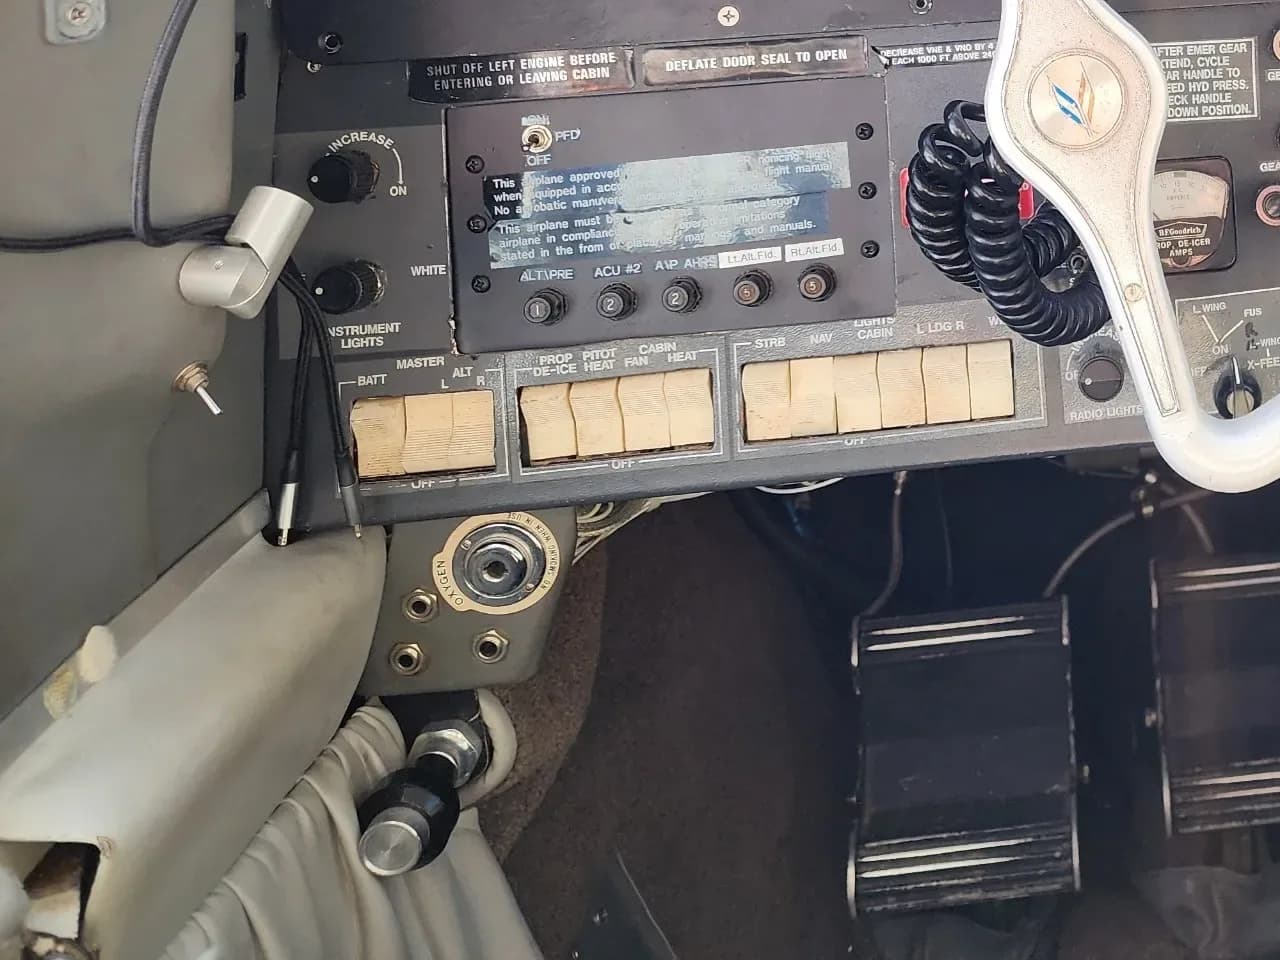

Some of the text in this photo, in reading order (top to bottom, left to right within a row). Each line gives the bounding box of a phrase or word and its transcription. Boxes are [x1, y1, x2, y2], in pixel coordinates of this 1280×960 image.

[1187, 43, 1248, 55] EMER GEAR
[427, 52, 616, 77] SHUT OFF LEFT ENGINE BEFORE
[665, 49, 848, 72] DEFLATE DOOR SEAL TO OPEN
[892, 56, 915, 65] EACH
[1197, 56, 1230, 67] CYCLE
[434, 67, 610, 90] ENTERING OR LEAVING CABIN
[1183, 68, 1241, 80] HANDLE TO
[1188, 79, 1249, 91] HYD PRESS.
[1192, 93, 1232, 104] HANDLE
[1202, 104, 1252, 115] POSITION.
[328, 131, 395, 153] INCREASE
[492, 168, 620, 189] This approved
[389, 186, 407, 197] ON
[494, 206, 510, 215] No
[527, 219, 569, 234] airplane
[500, 236, 541, 248] airplane
[500, 250, 535, 261] stated
[411, 265, 446, 276] WHITE
[594, 266, 621, 278] ACU
[1244, 308, 1262, 317] FUS
[857, 327, 893, 340] CABIN
[928, 322, 952, 333] LDG
[341, 337, 384, 349] LIGHTS
[755, 338, 786, 349] STRB
[810, 333, 833, 345] NAV
[639, 342, 677, 354] CABIN
[539, 353, 573, 364] PROP
[583, 348, 617, 361] PITOT
[667, 351, 697, 362] HEAT
[396, 356, 445, 370] MASTER
[584, 359, 616, 371] HEAT
[624, 357, 649, 368] FAN
[453, 367, 473, 378] ALT
[533, 362, 577, 377] DE-ICE
[358, 374, 387, 386] BATT
[1070, 405, 1144, 421] RADIO LIGHTS
[611, 459, 635, 470] OFF
[437, 560, 464, 606] OXYGEN
